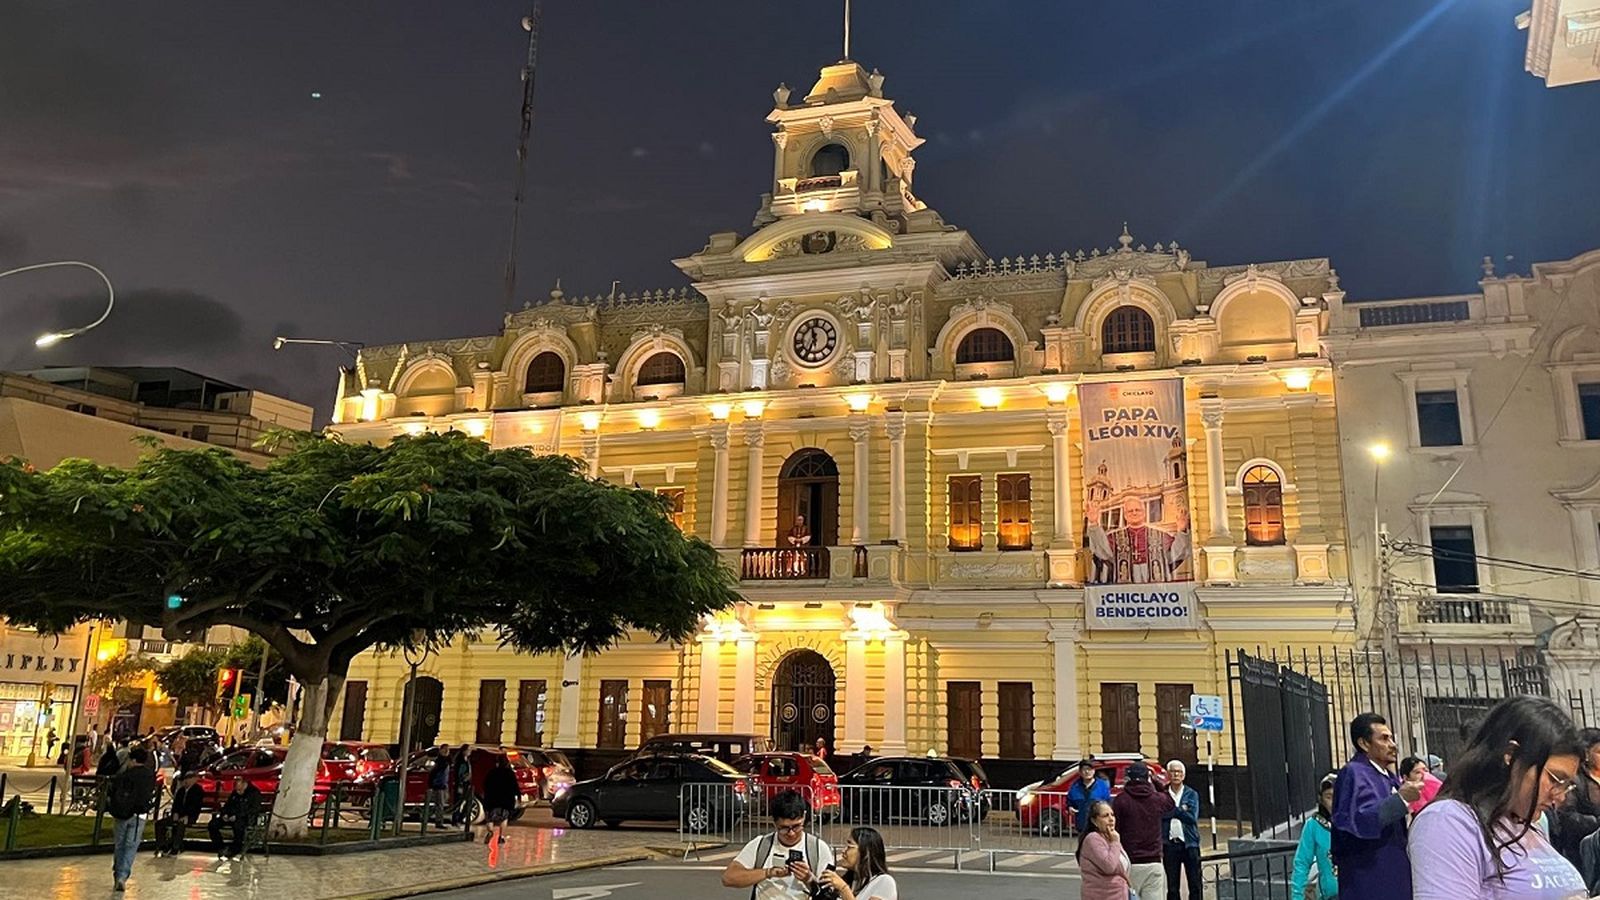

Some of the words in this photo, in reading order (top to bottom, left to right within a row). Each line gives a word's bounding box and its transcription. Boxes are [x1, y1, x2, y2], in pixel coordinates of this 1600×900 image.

[1103, 407, 1159, 422] PAPA
[1088, 422, 1138, 441] LEÓN
[1143, 424, 1177, 439] XIV
[1101, 592, 1179, 605] ¡CHICLAYO
[1096, 606, 1188, 618] BENDECIDO!
[0, 653, 82, 672] IPLEY
